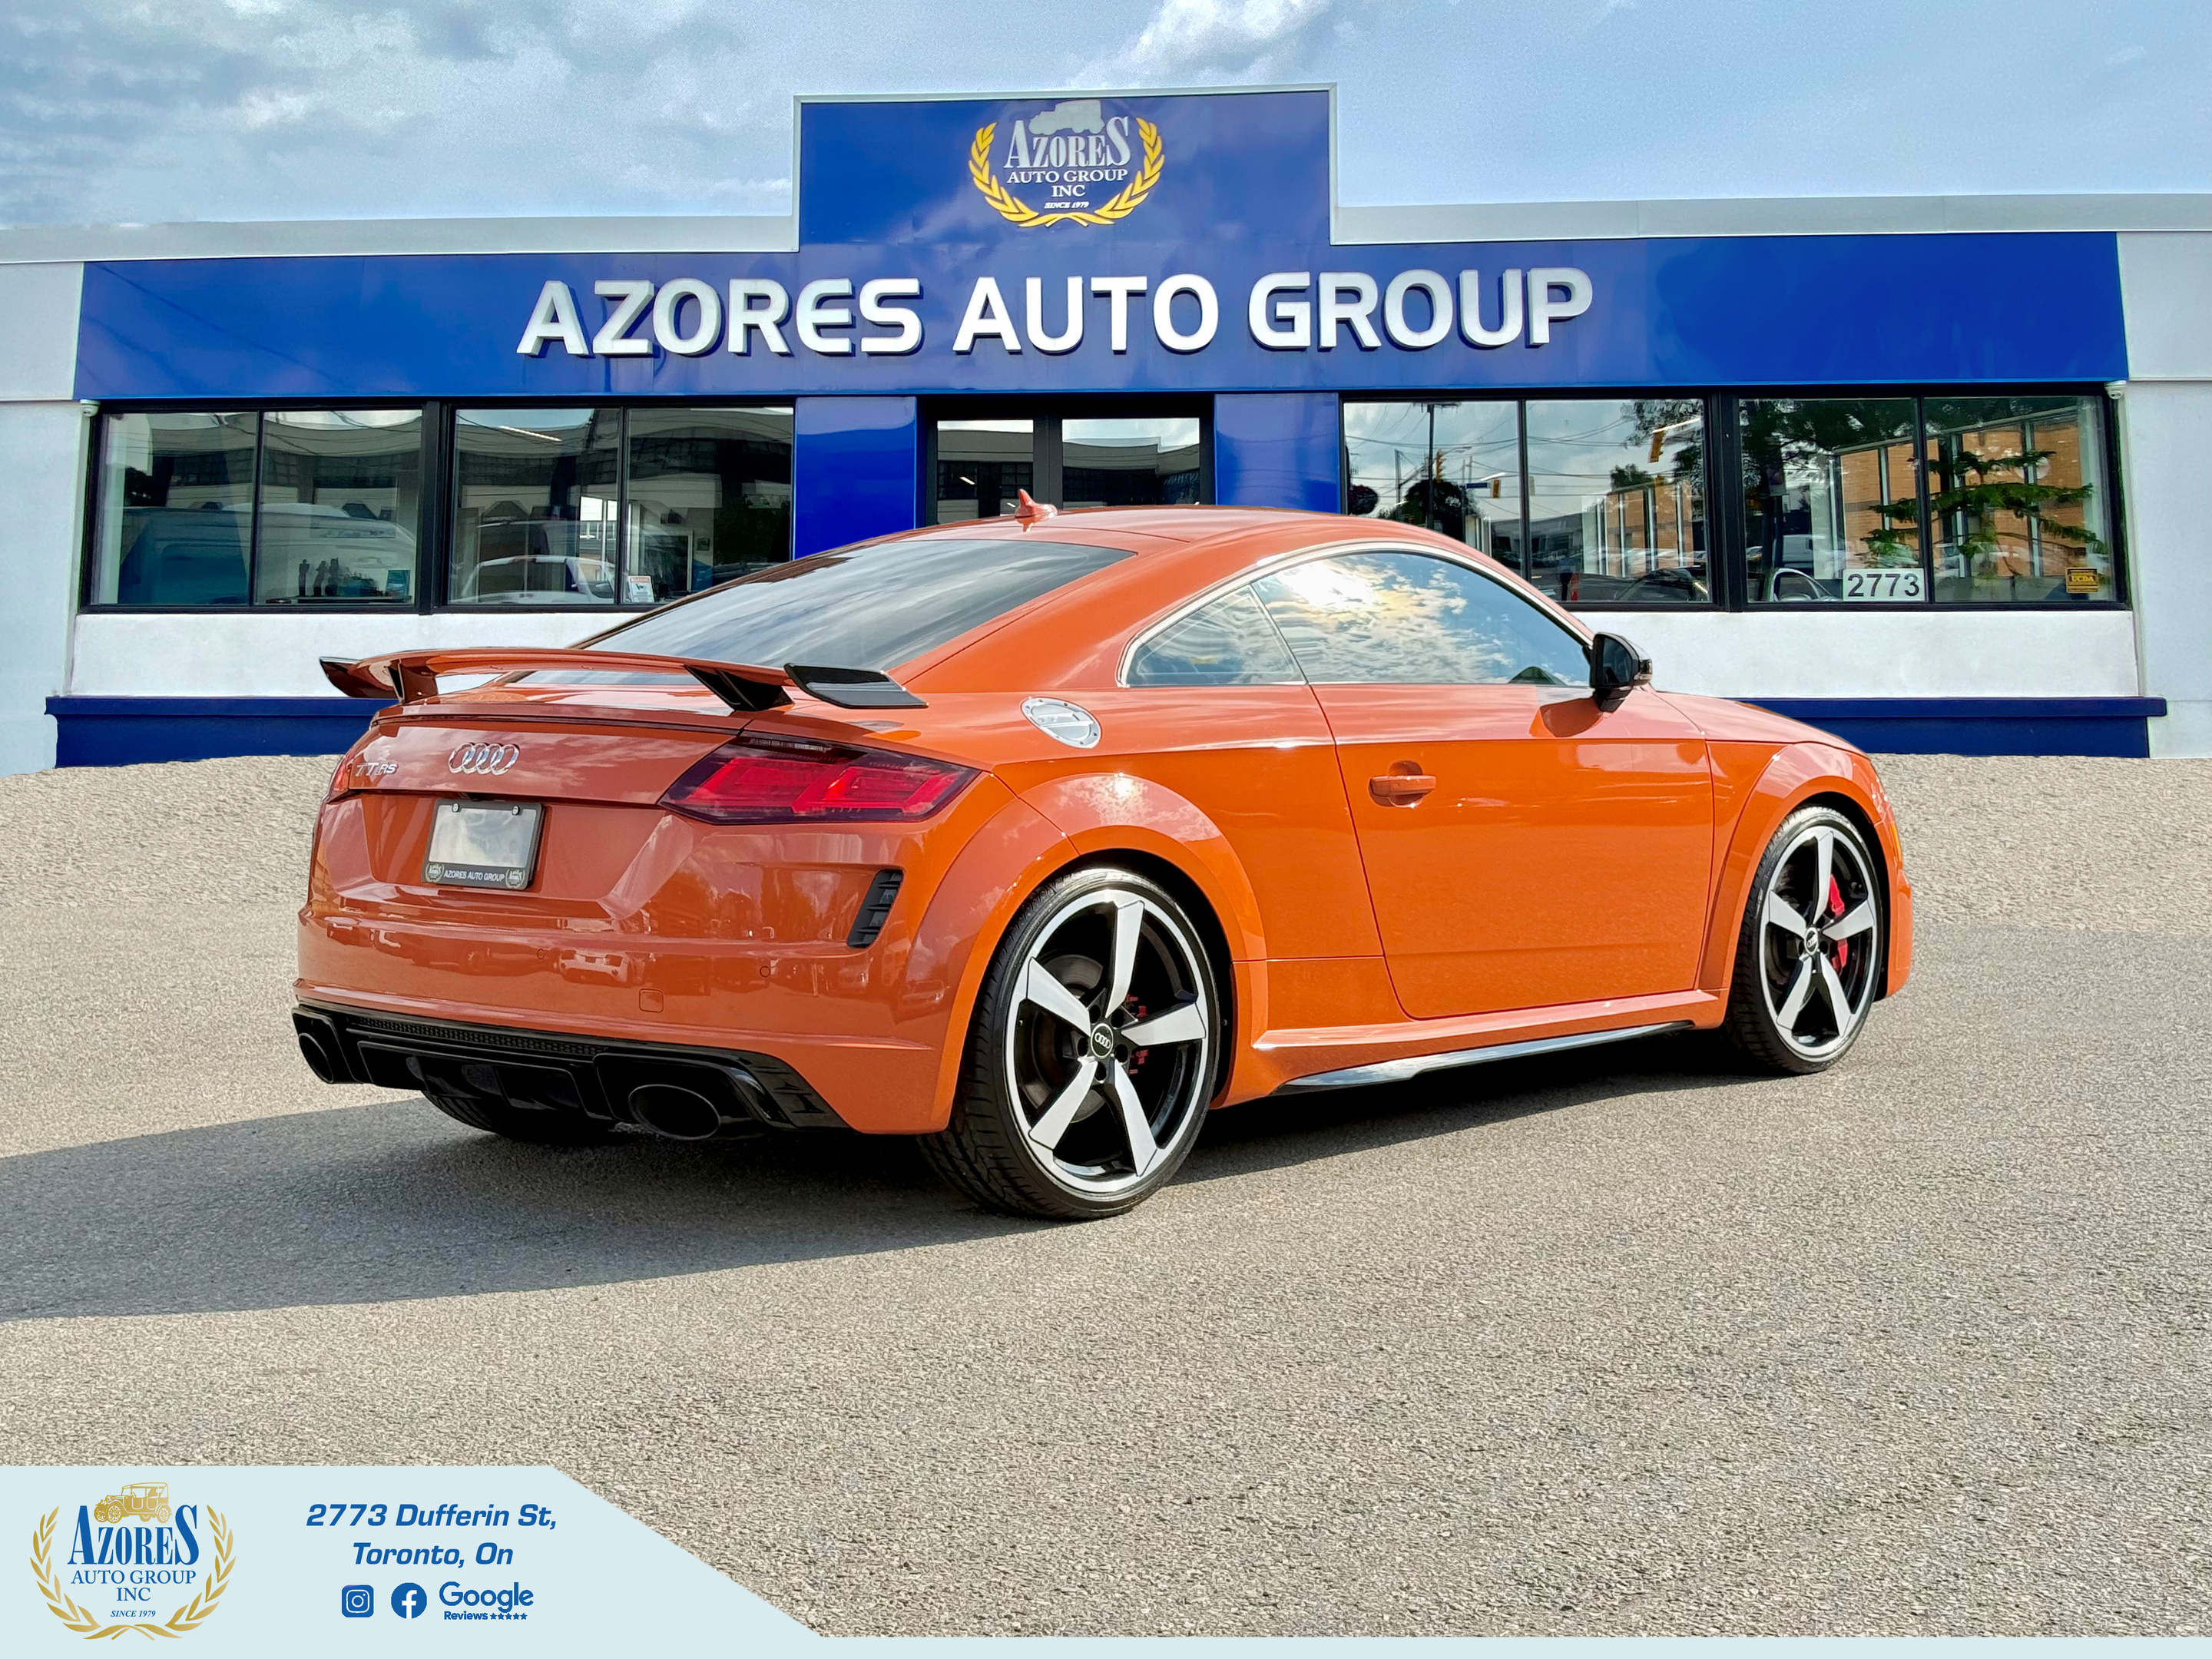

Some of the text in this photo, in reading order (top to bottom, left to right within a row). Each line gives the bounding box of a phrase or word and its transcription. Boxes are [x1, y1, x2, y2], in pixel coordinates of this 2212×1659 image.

[1003, 116, 1131, 168] AZORES
[1007, 169, 1128, 184] AUTO GROUP
[1051, 184, 1086, 197] INC
[516, 267, 1593, 357] AZORES AUTO GROUP
[1848, 573, 1919, 597] 2773
[443, 869, 467, 879] AZORES
[467, 871, 484, 881] AUTO
[484, 873, 505, 882] GROUP
